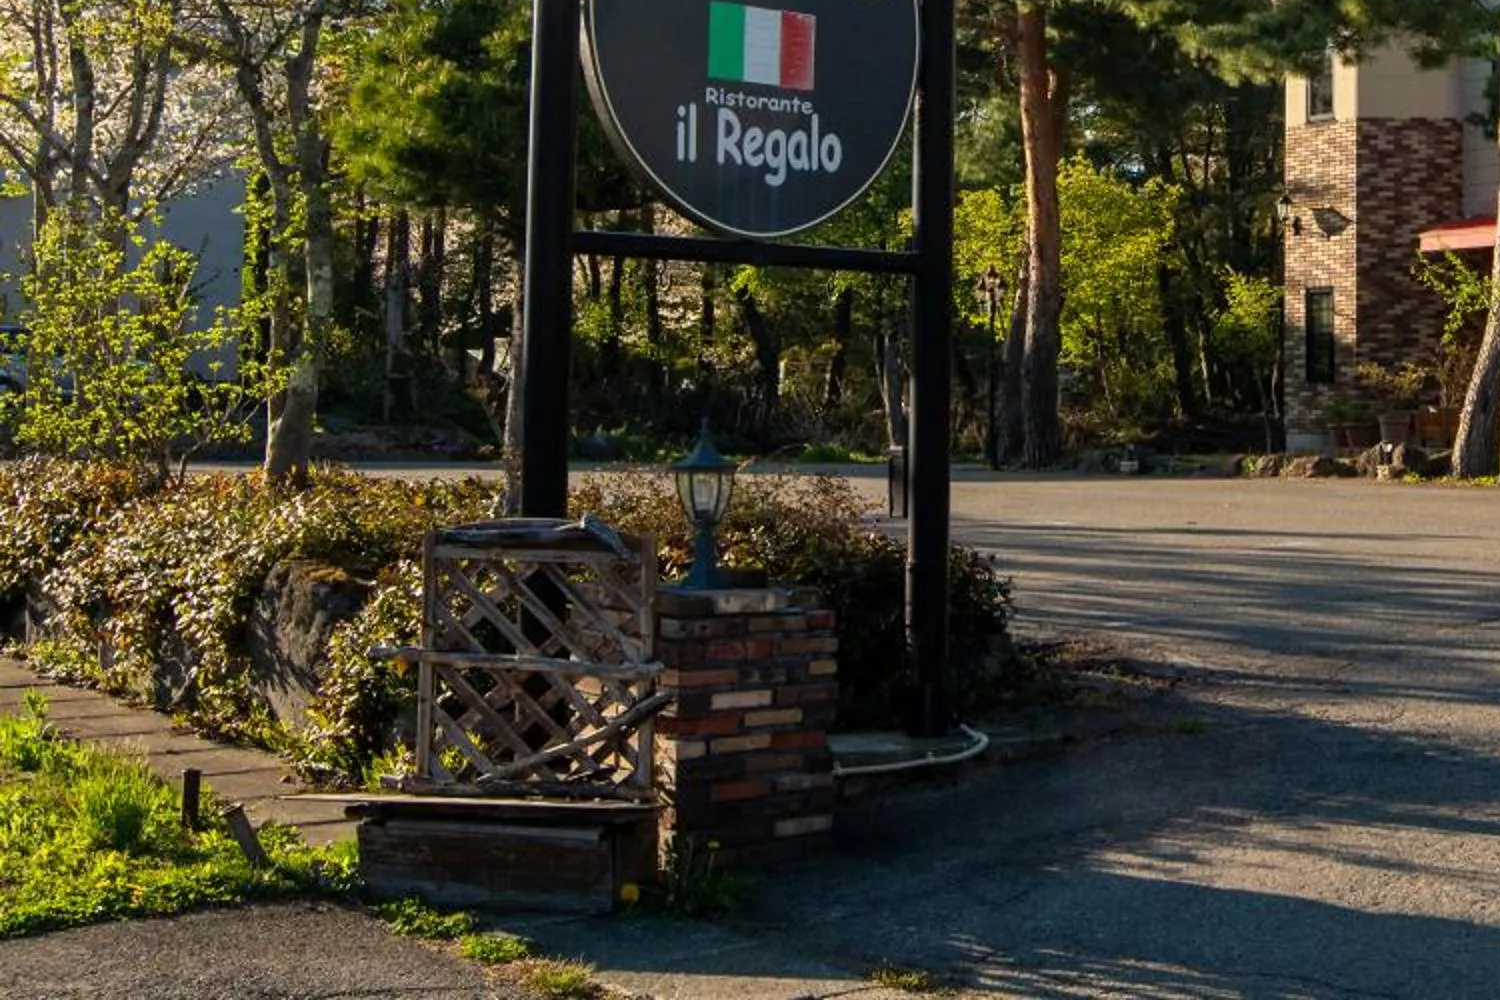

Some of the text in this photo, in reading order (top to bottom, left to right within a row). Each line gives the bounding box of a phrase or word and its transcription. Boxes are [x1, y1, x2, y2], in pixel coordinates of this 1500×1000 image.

[705, 87, 813, 114] Ristorante
[677, 102, 842, 187] il Regalo
